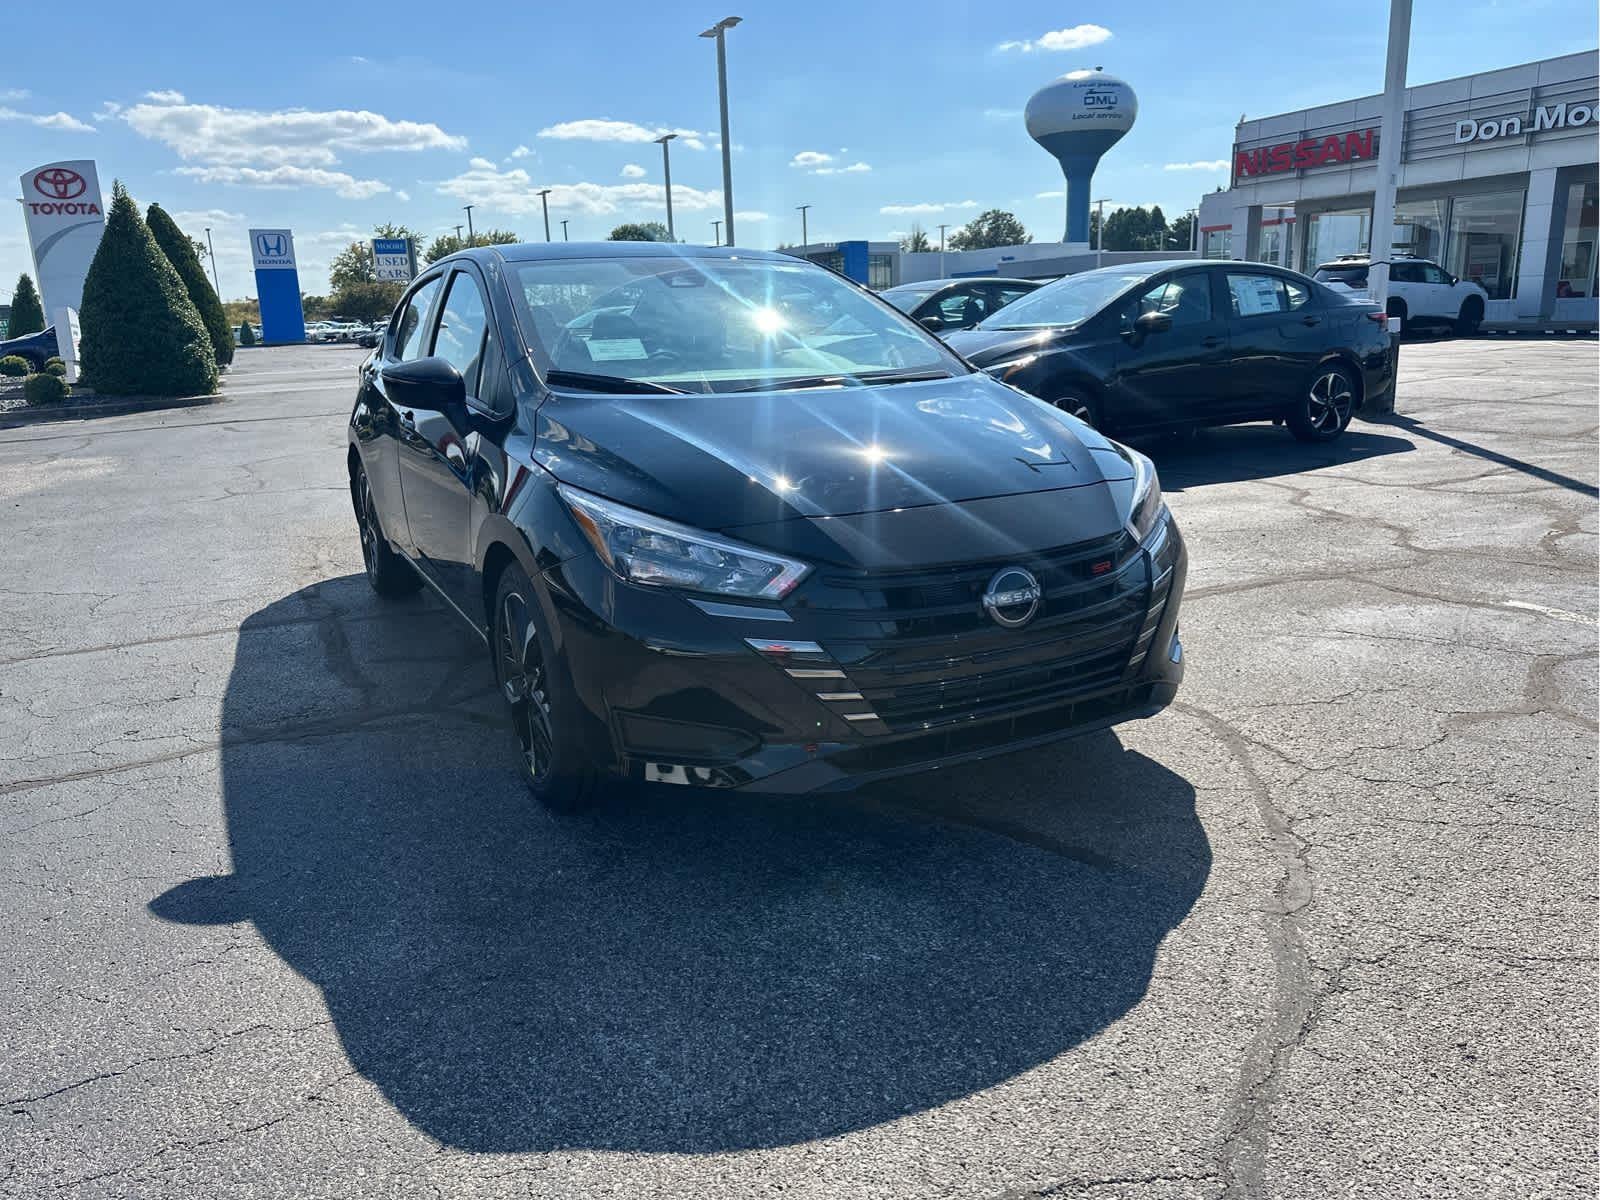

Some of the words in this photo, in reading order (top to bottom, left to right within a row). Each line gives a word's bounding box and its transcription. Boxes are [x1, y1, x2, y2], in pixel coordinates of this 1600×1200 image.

[1455, 117, 1520, 144] Don
[1236, 129, 1373, 177] NISSAN
[29, 203, 100, 215] TOYOTA
[377, 257, 408, 266] USED
[378, 270, 410, 278] CARS
[983, 585, 1040, 605] NISSAN
